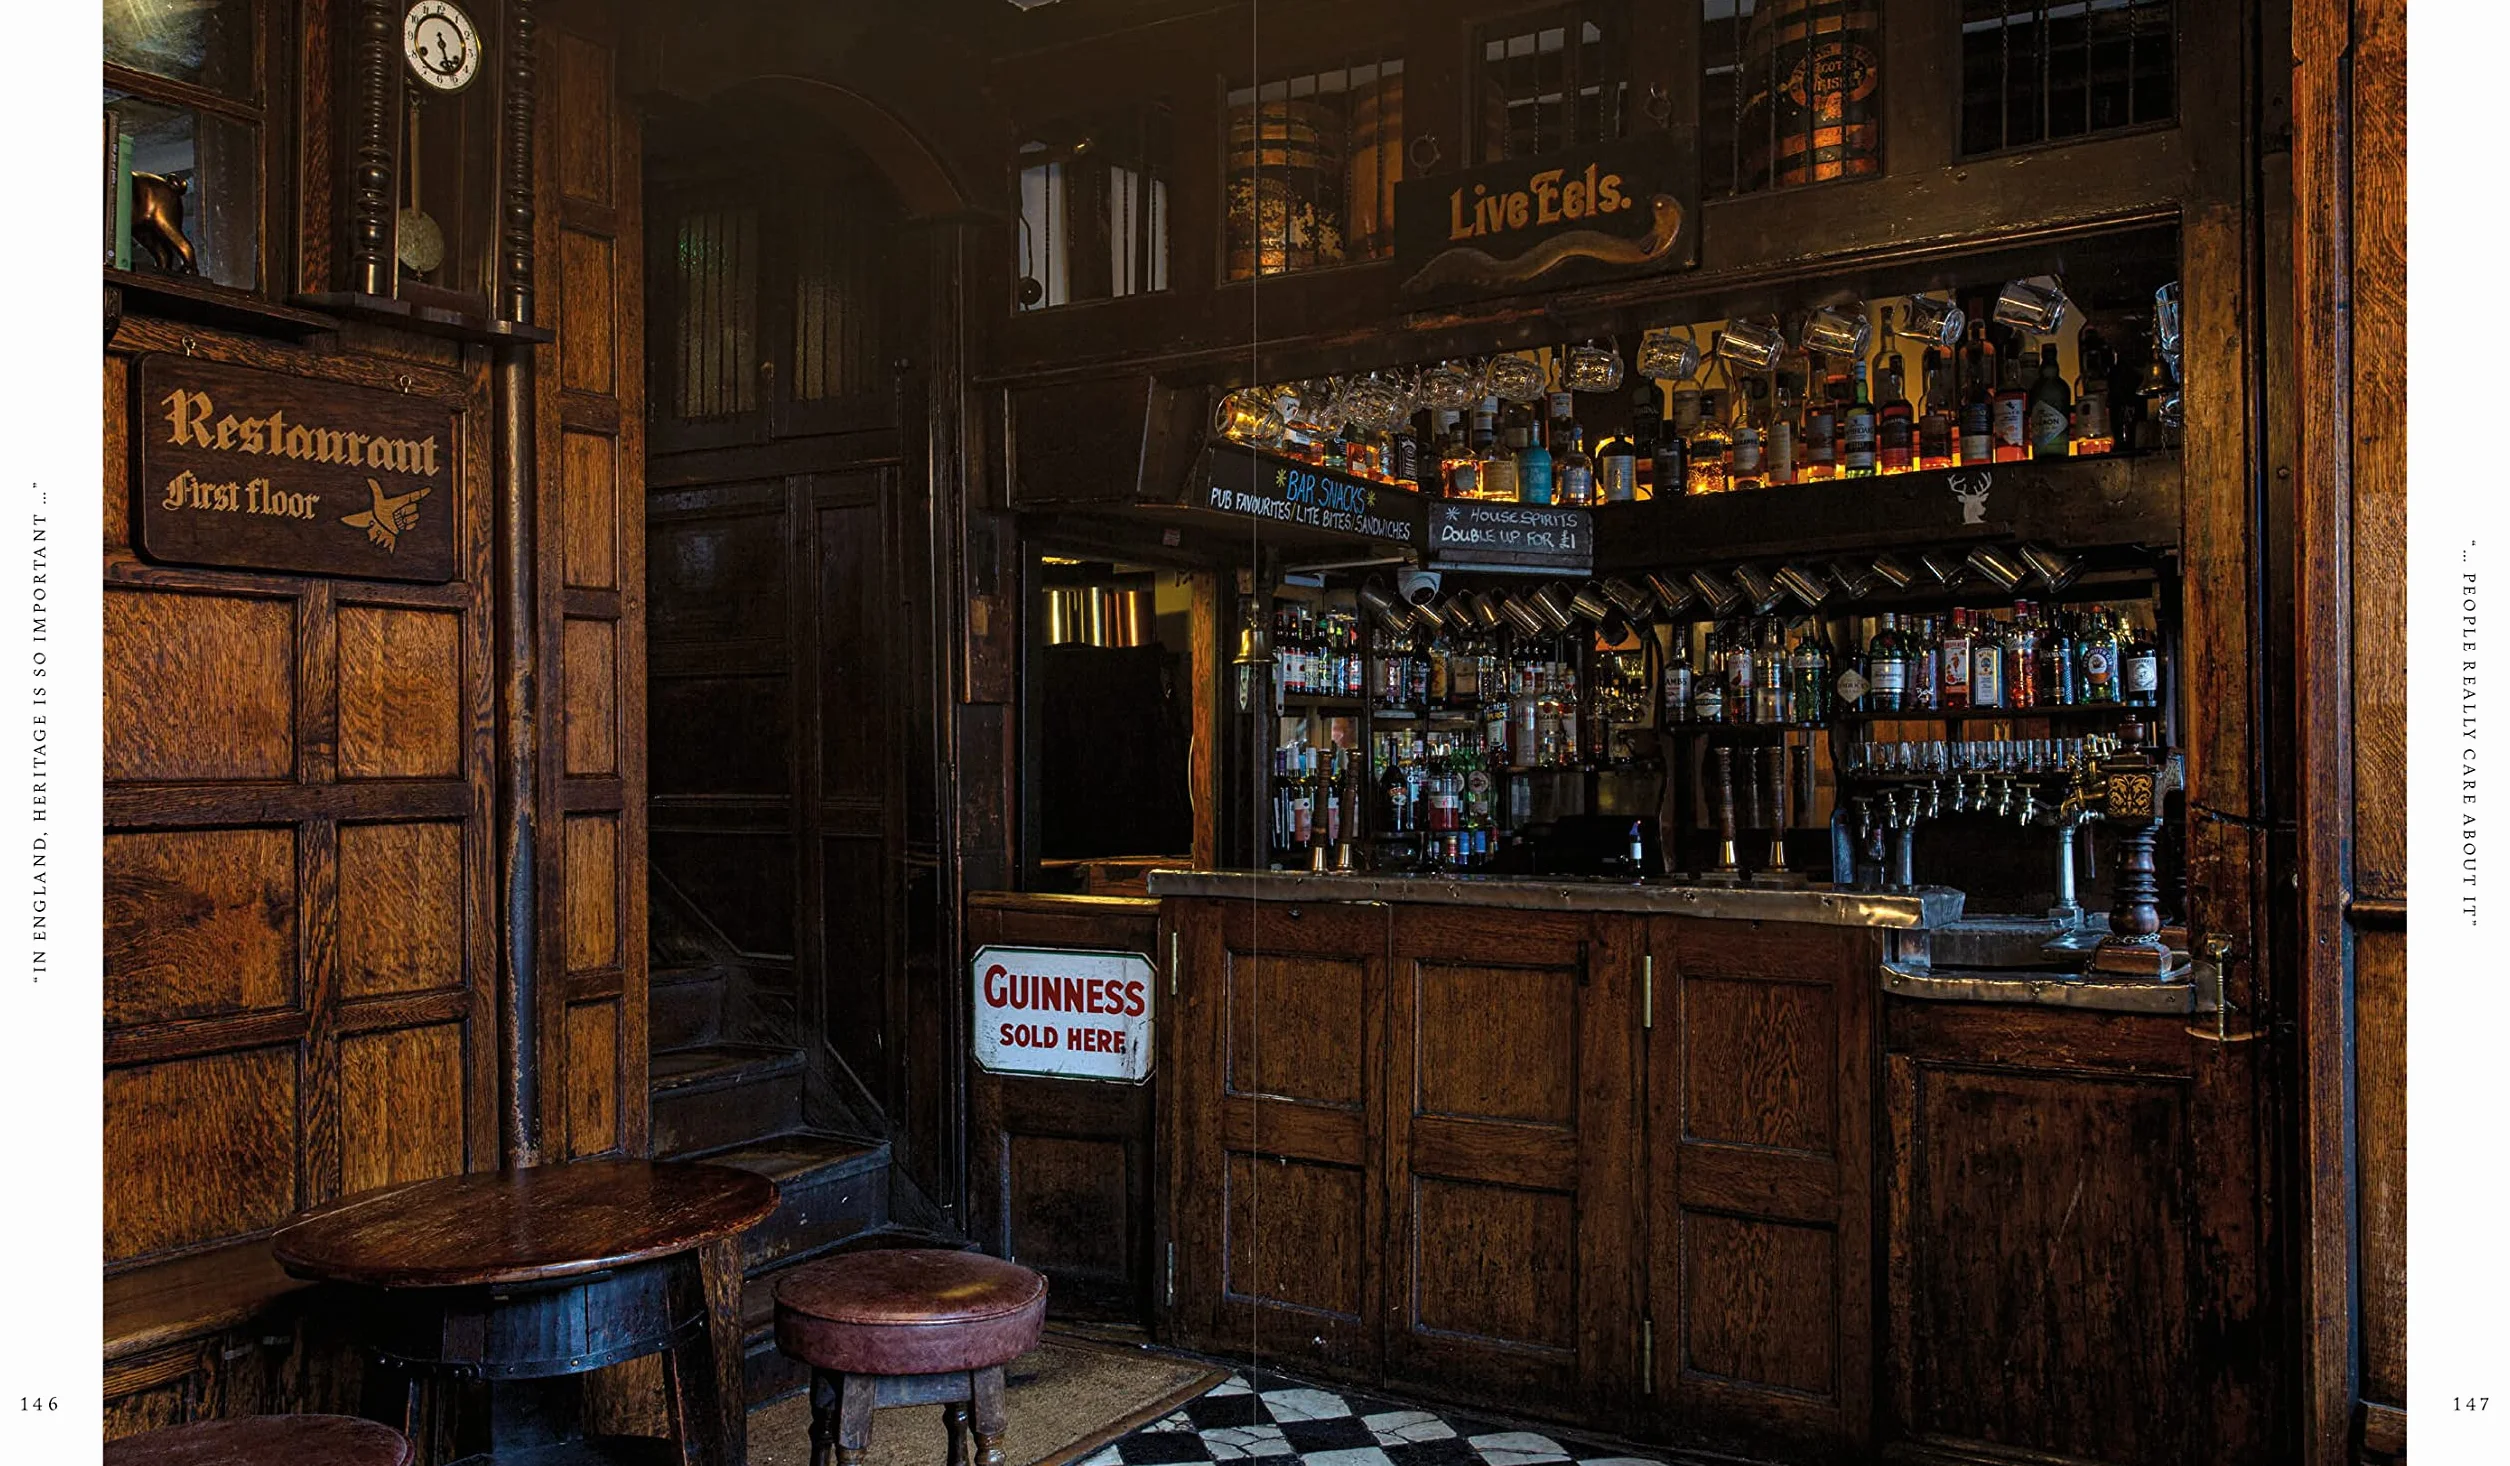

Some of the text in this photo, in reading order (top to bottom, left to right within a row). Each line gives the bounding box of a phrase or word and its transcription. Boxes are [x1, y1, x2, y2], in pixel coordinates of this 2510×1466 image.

[1449, 163, 1632, 240] Live Eels.
[161, 388, 440, 477] Restaurant
[162, 469, 320, 520] First floor
[1210, 487, 1232, 510] PUB
[1286, 470, 1366, 514] BAR SNACKS
[1441, 525, 1576, 549] DOUBLE UP FOR £1
[1471, 508, 1578, 528] HOUSE SPIRITS
[984, 964, 1146, 1017] GUINNESS
[1000, 1023, 1059, 1048] SOLD
